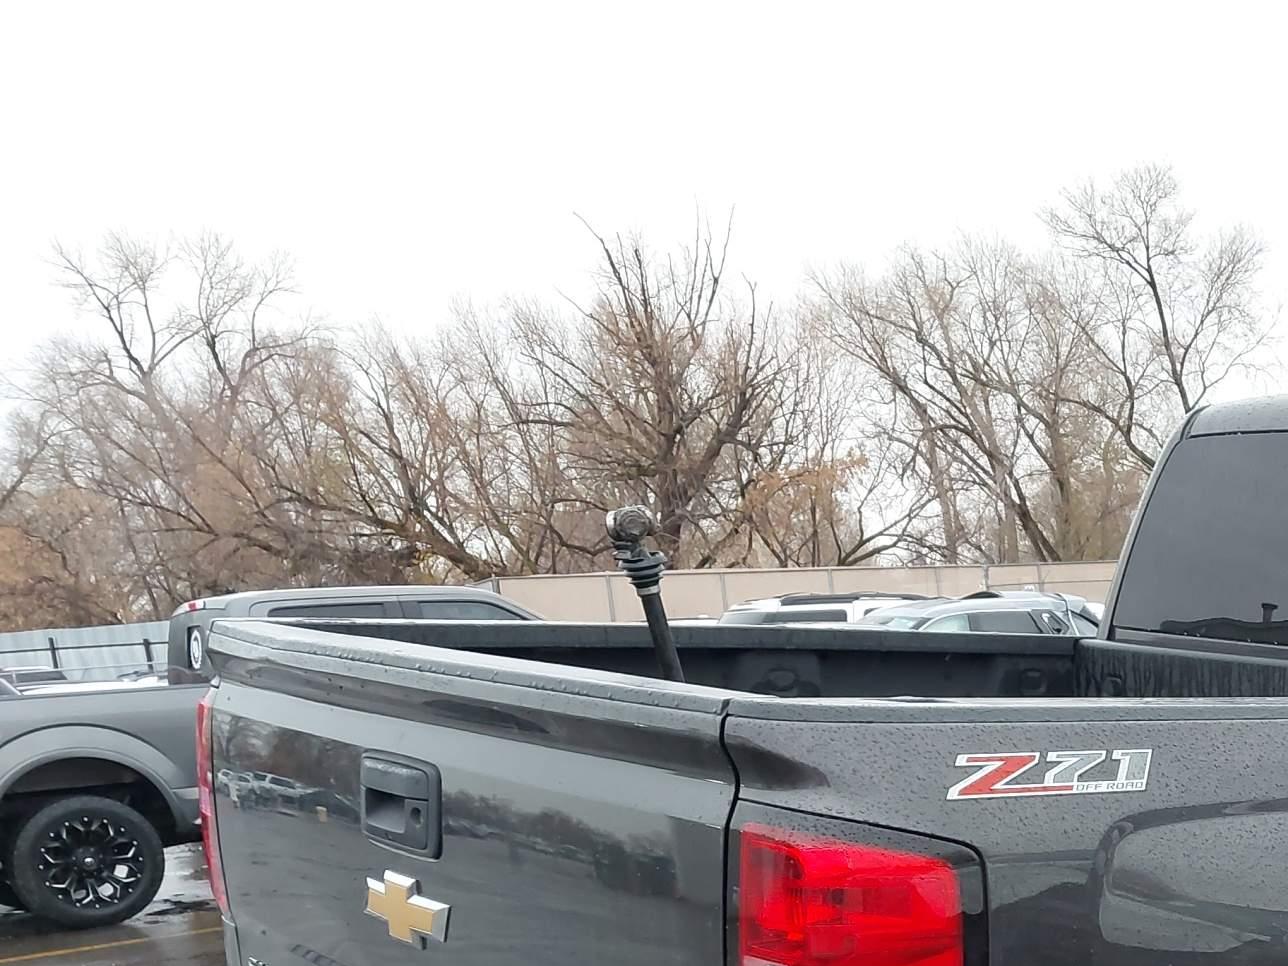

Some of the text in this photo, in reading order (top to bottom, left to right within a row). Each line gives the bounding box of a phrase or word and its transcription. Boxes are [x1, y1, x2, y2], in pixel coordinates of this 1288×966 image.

[946, 749, 1152, 800] Z71
[1075, 780, 1144, 792] OFF ROAD
